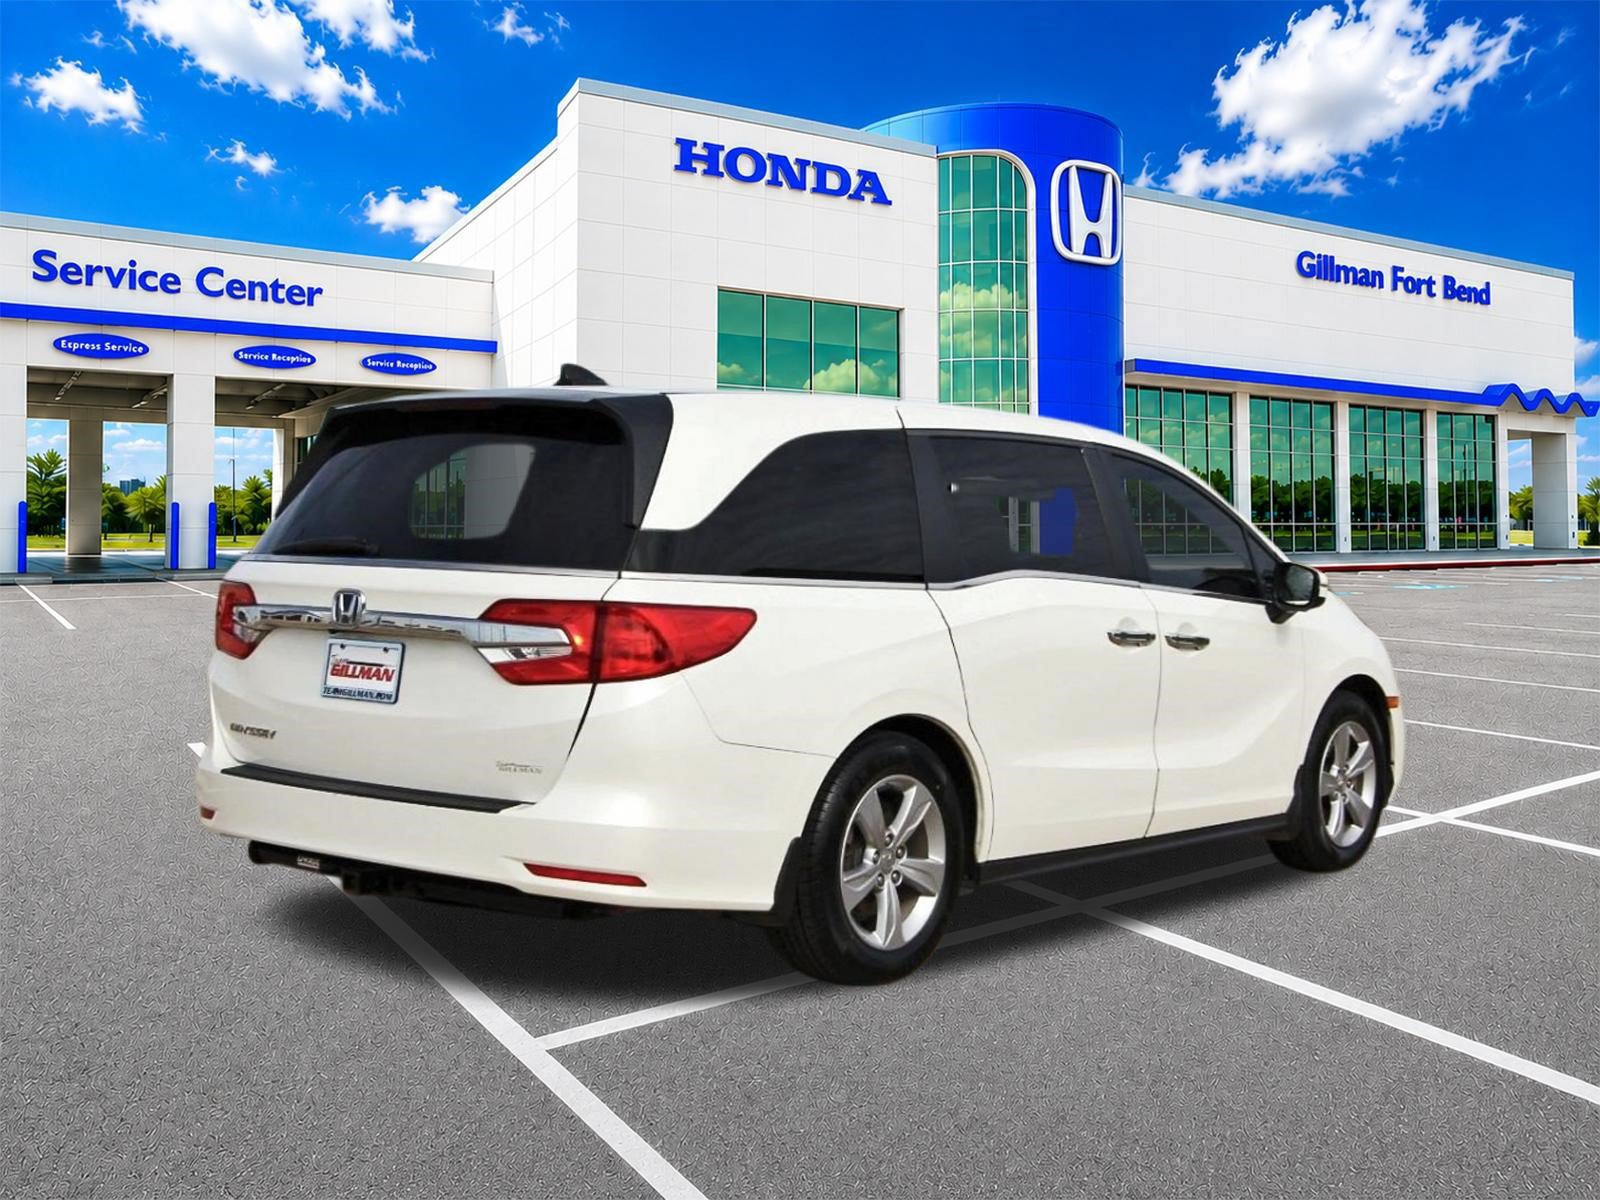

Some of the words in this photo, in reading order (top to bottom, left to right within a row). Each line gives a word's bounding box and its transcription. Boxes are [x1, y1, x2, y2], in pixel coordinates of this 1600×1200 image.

[673, 136, 893, 206] HONDA
[32, 248, 182, 295] Service
[195, 266, 324, 307] Center
[1296, 250, 1385, 289] Gillman
[1391, 265, 1437, 298] Fort
[1442, 275, 1491, 306] Bend
[104, 342, 144, 354] Service
[238, 351, 269, 361] Service
[330, 663, 396, 683] GILLMAN
